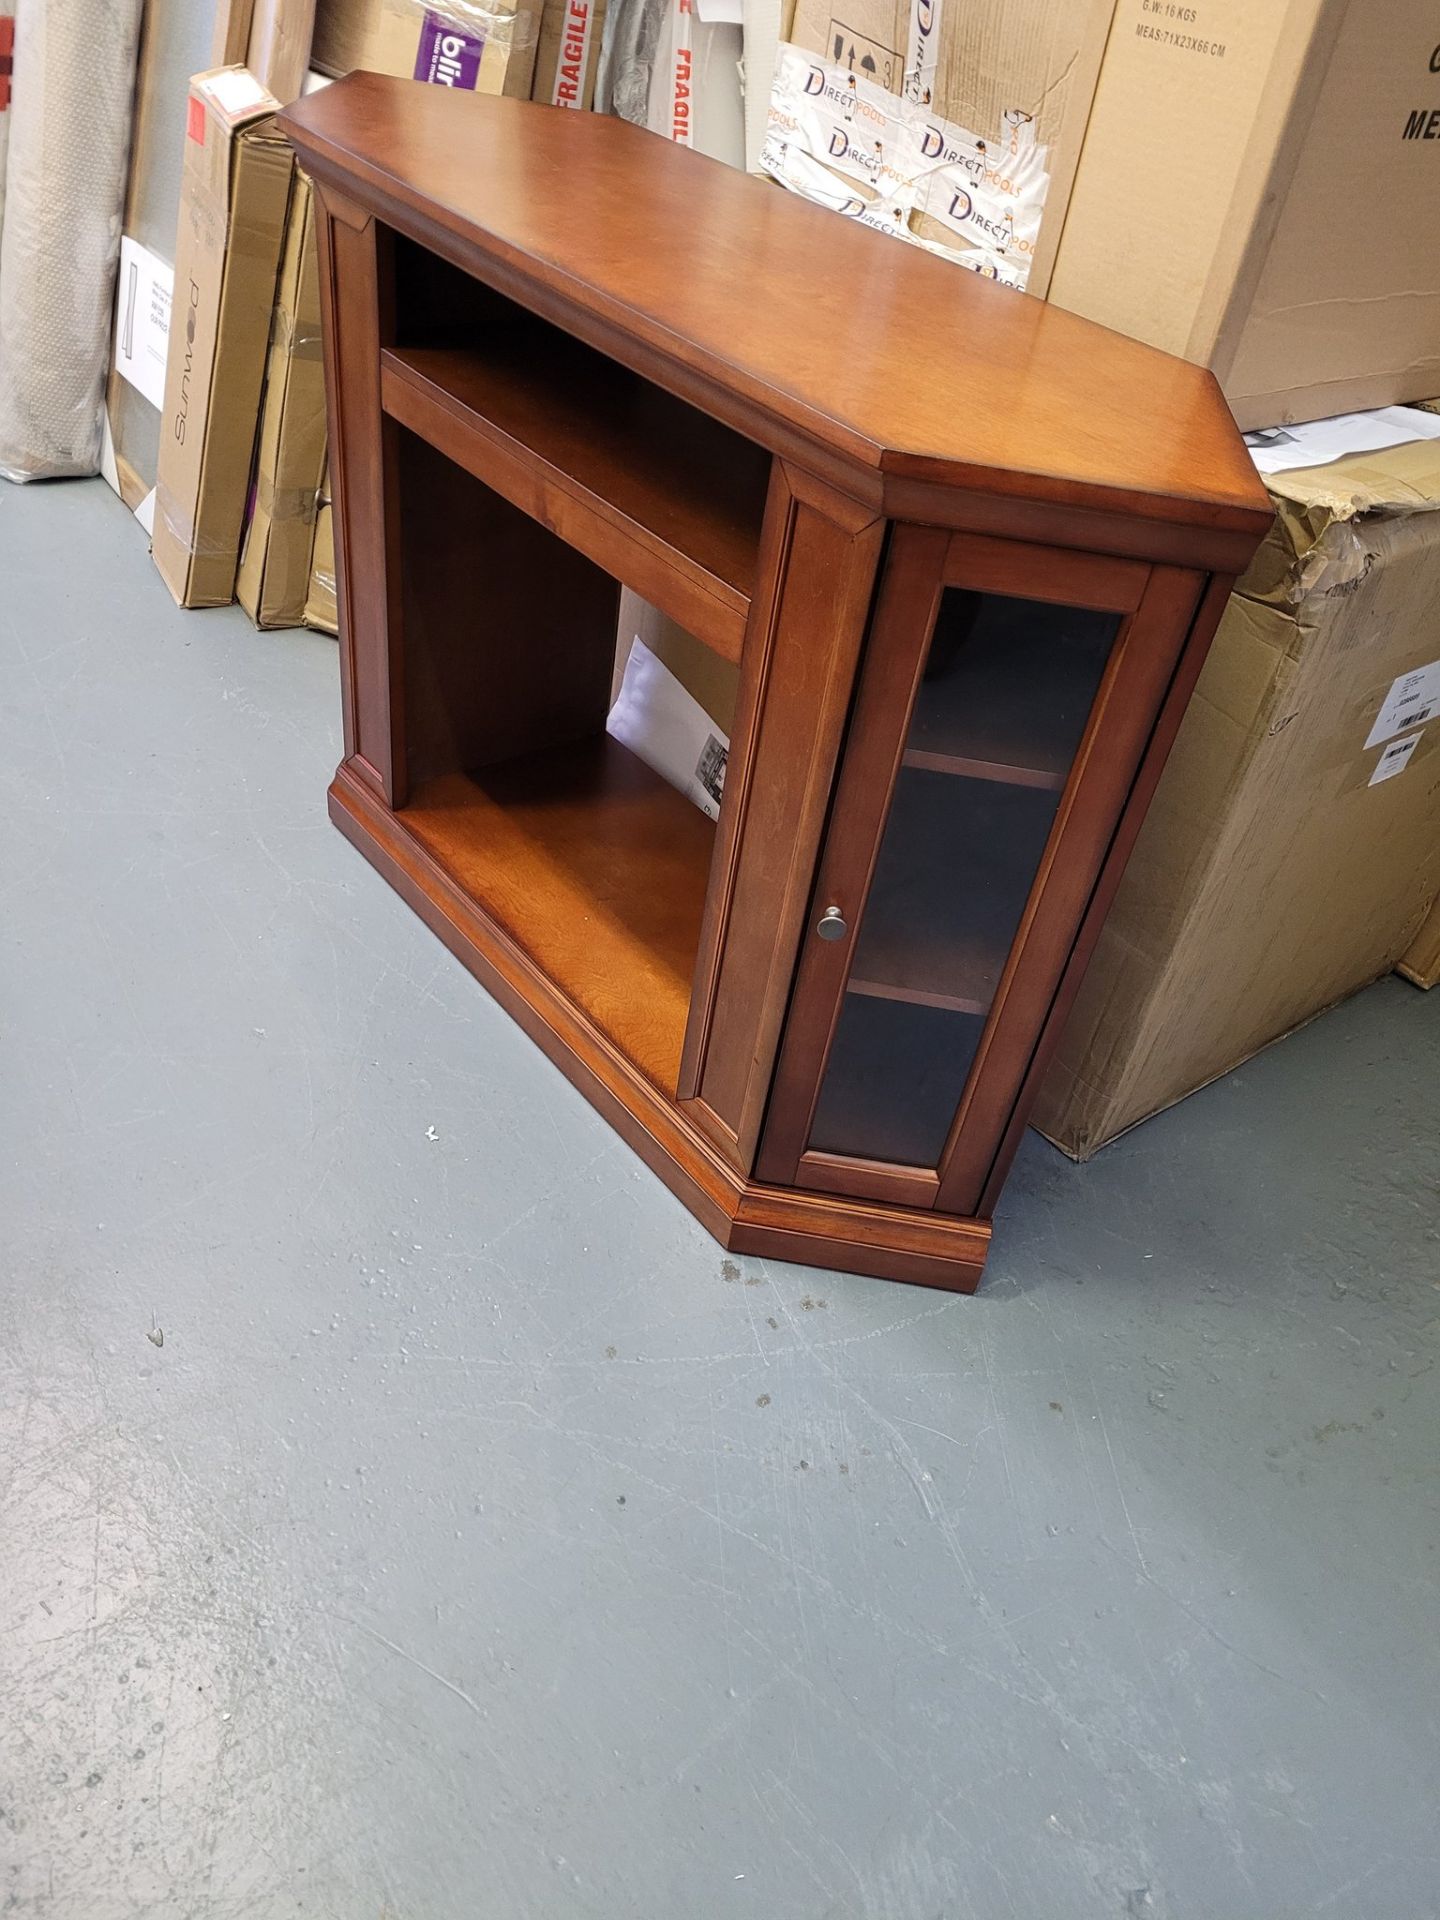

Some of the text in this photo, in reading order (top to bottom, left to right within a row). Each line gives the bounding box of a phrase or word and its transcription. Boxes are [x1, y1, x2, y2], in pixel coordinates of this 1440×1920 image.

[1164, 5, 1176, 18] 16
[1176, 6, 1197, 23] KGS
[1135, 23, 1226, 57] MEAS:71X23X66 CM
[803, 64, 887, 128] DIRECT POOLS
[1402, 109, 1440, 141] ME
[829, 126, 881, 171] DIRECT
[921, 124, 984, 175] DIRECT
[984, 169, 1024, 198] POOLS
[838, 197, 896, 235] DIRECT
[948, 186, 1010, 241] DIRECT
